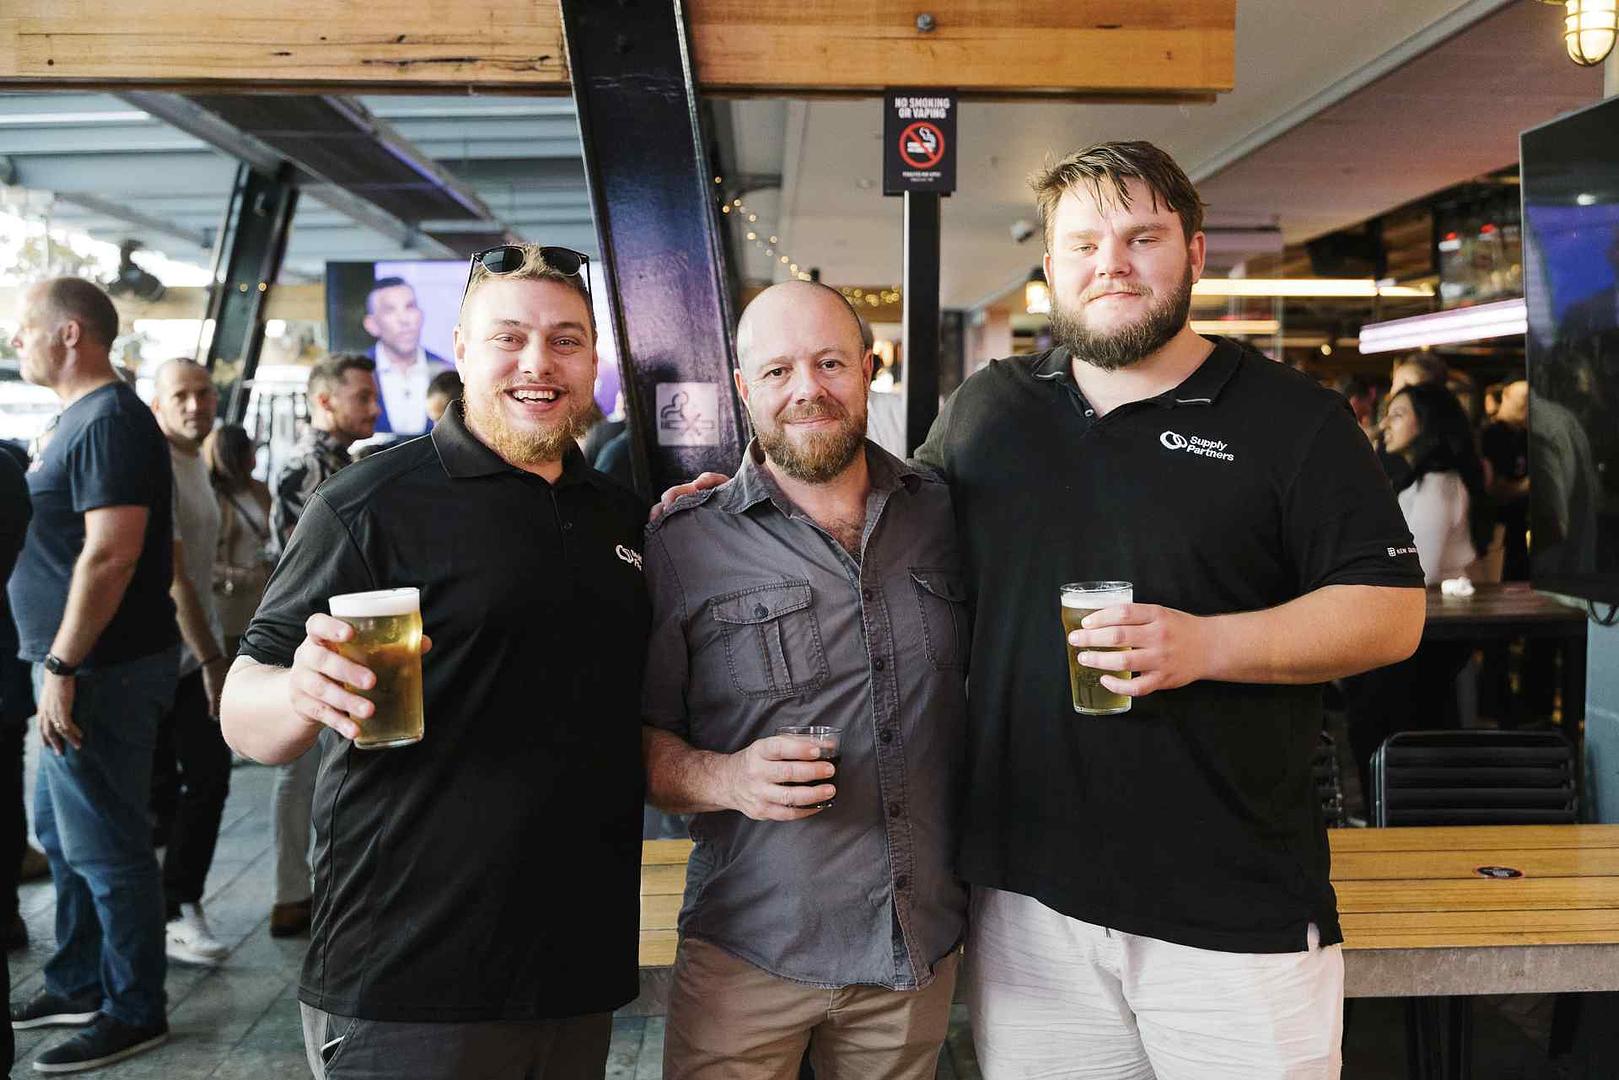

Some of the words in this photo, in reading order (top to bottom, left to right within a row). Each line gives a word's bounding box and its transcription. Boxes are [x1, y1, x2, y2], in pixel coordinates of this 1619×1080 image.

[894, 97, 908, 108] NO
[909, 97, 951, 109] SMOKING
[898, 107, 912, 119] OR
[912, 107, 947, 119] VAPING
[1189, 436, 1228, 451] Supply
[1186, 445, 1235, 461] Partners
